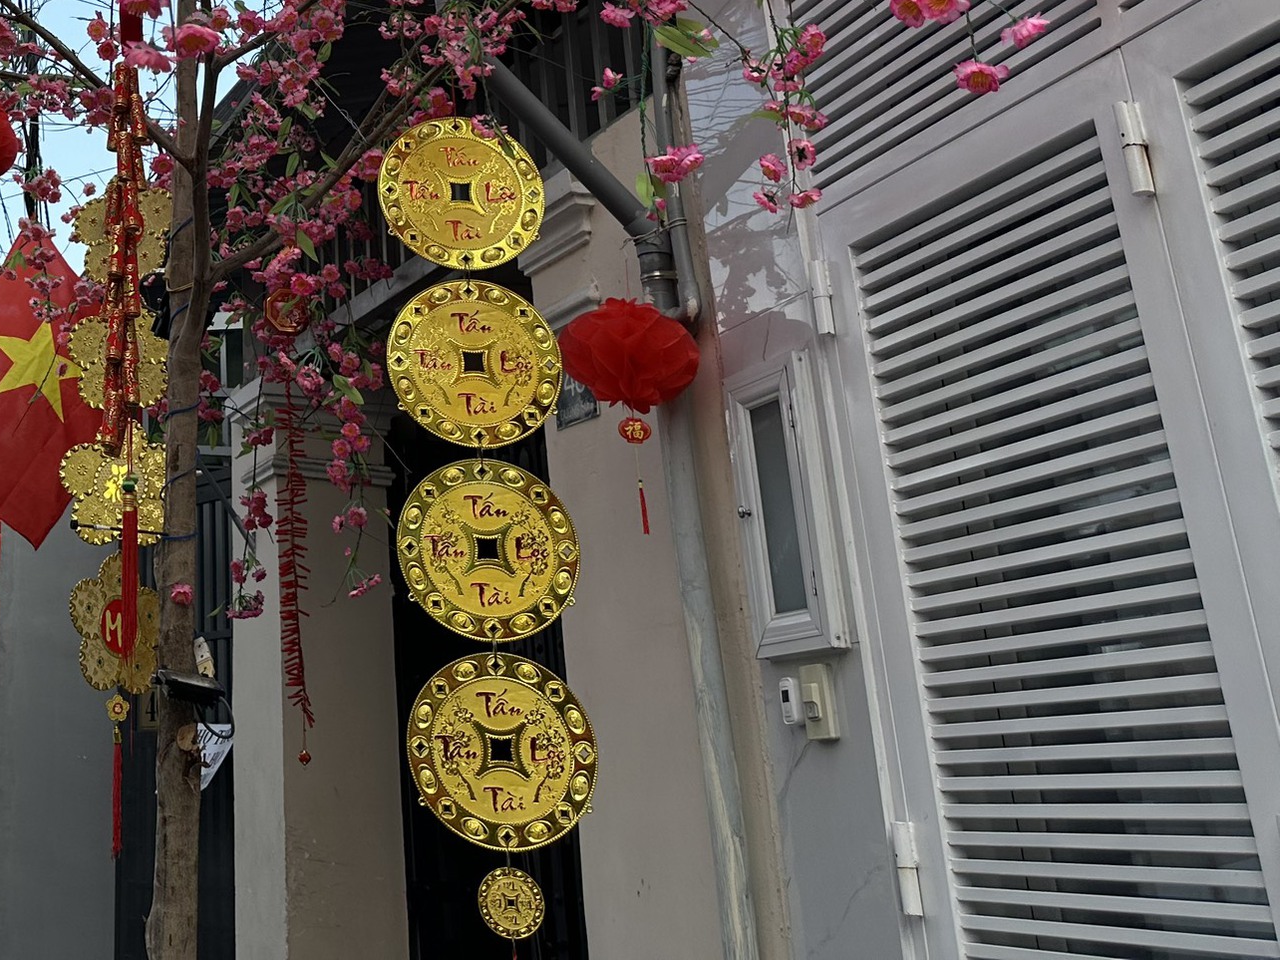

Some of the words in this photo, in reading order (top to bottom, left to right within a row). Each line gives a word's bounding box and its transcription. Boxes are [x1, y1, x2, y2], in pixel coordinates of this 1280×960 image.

[439, 146, 479, 167] Tấn
[445, 220, 482, 241] Tài
[450, 309, 493, 335] Tấn
[457, 392, 497, 416] Tài
[624, 421, 644, 439] 福
[463, 492, 510, 519] Tấn
[423, 532, 467, 559] Tấn
[470, 582, 512, 607] Tài
[476, 688, 524, 718] Tấn
[434, 730, 479, 760] Tấn
[482, 786, 526, 813] Tài
